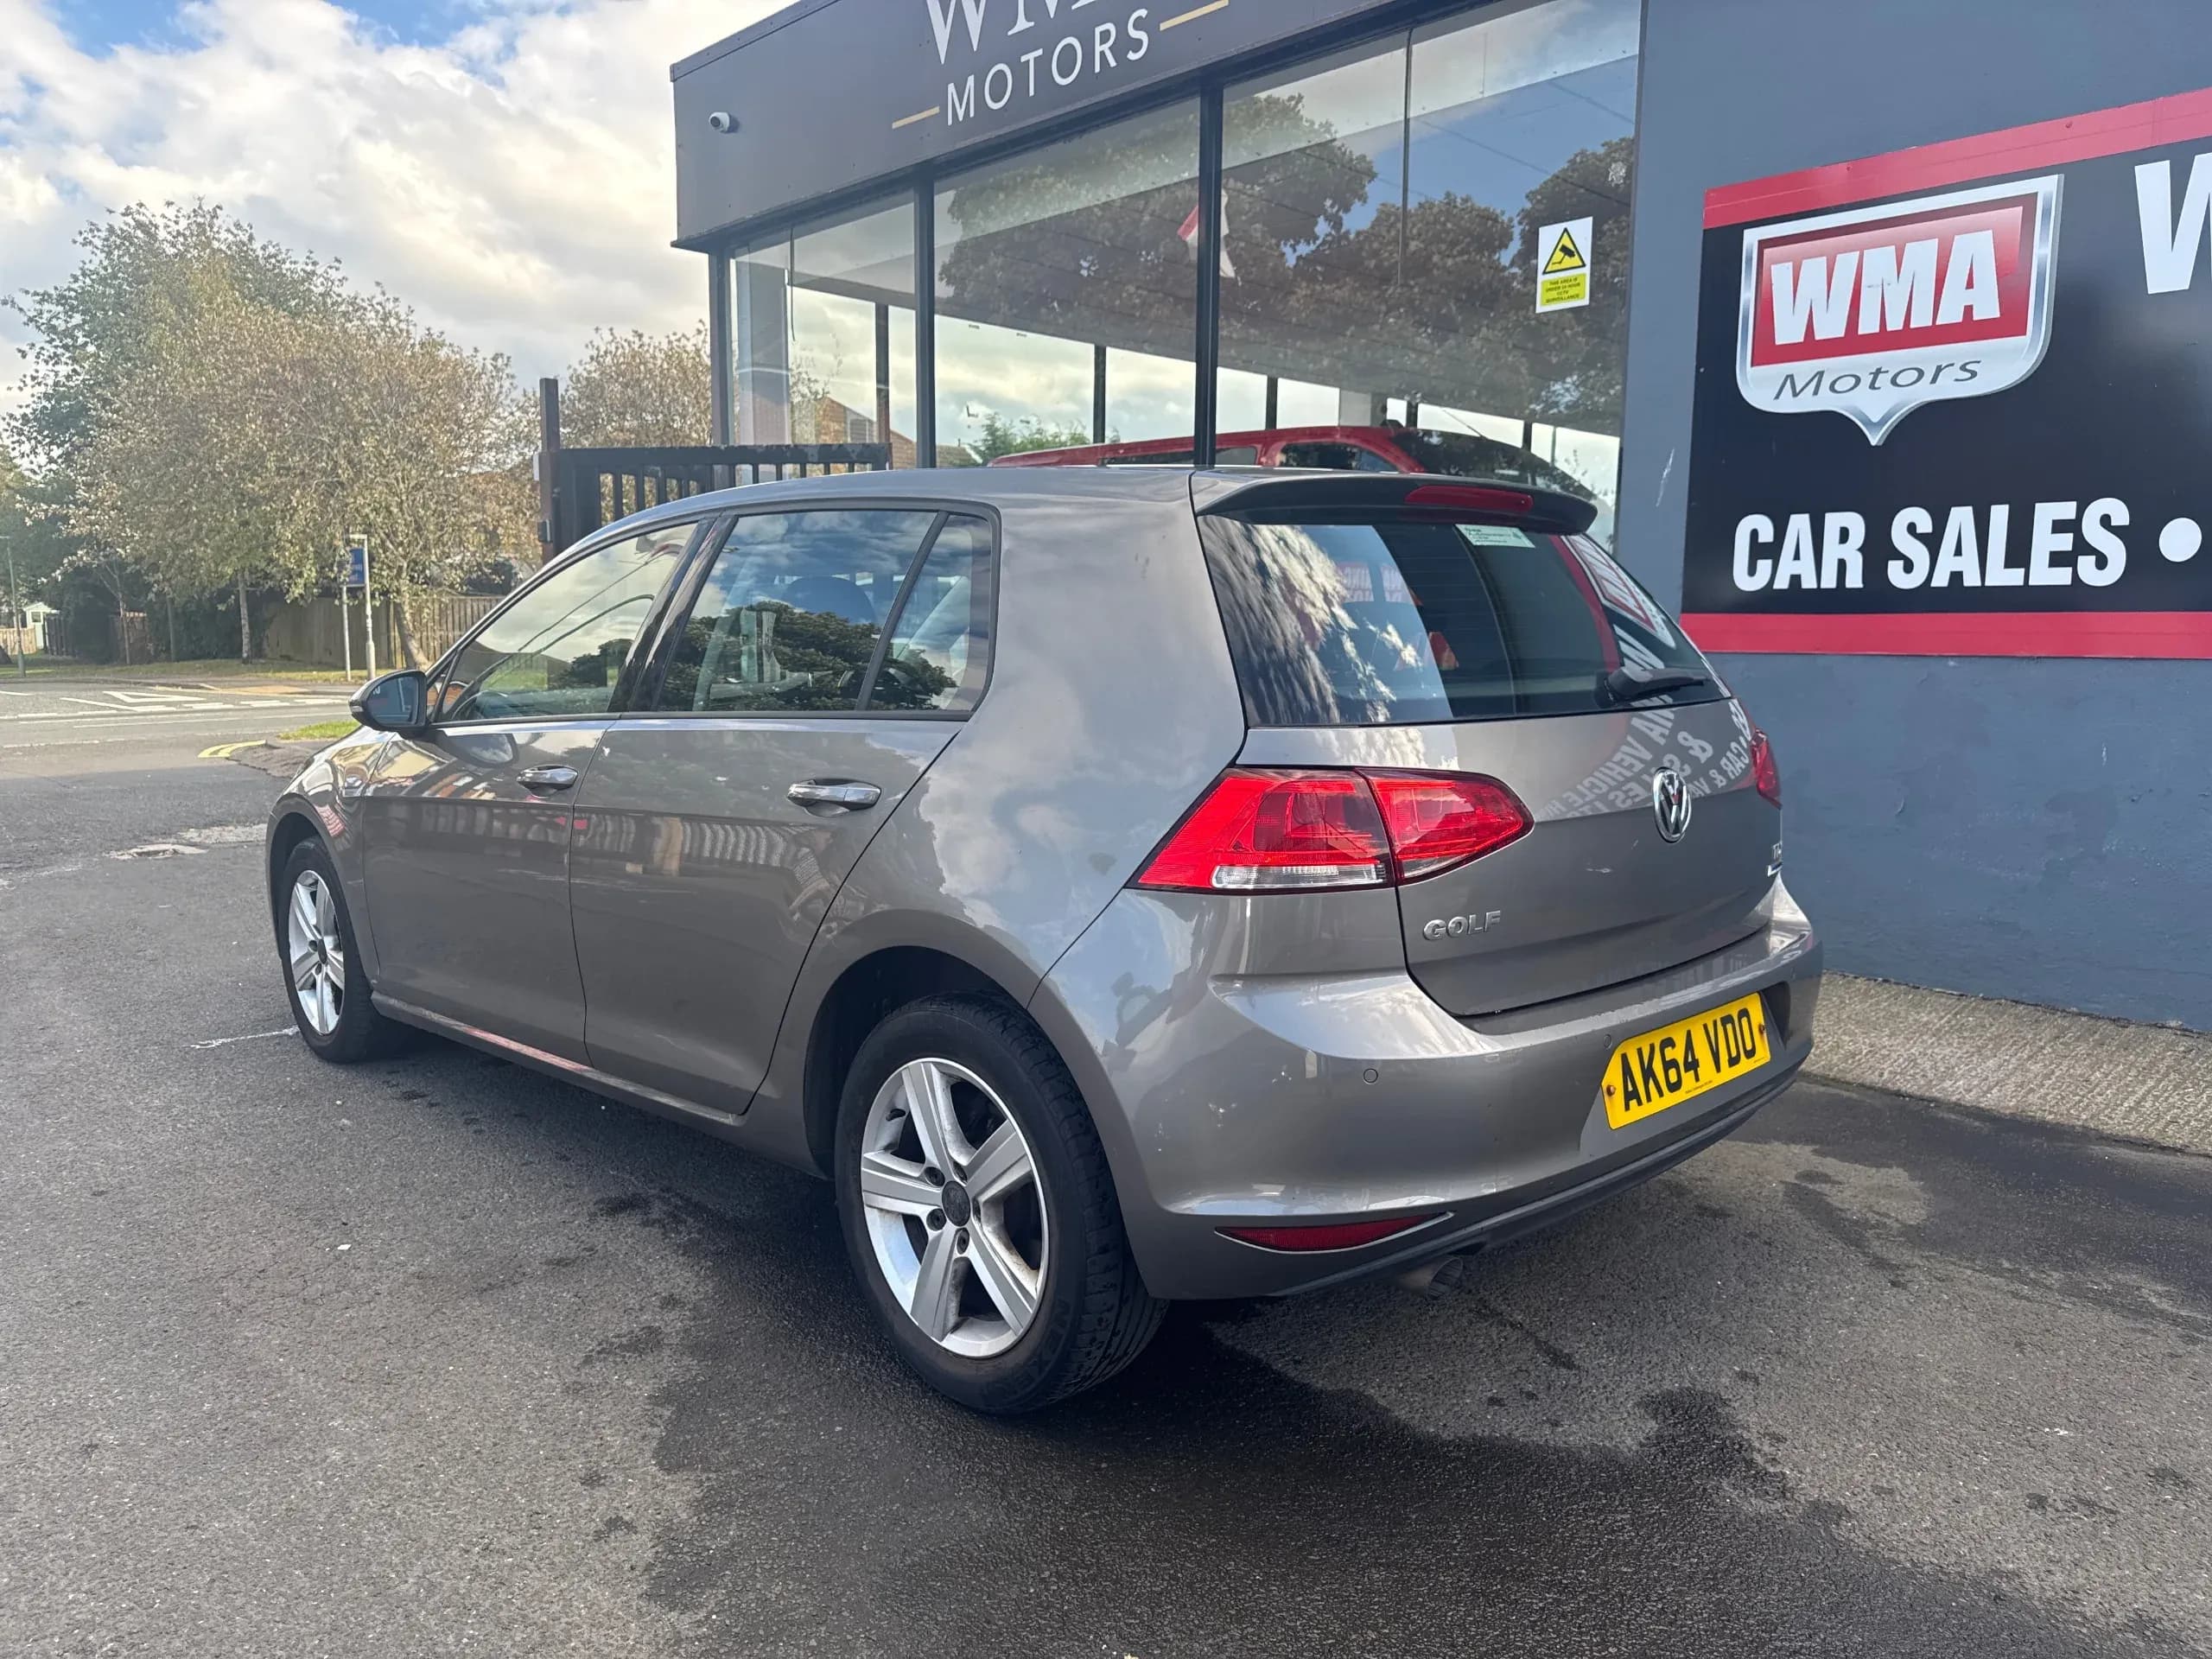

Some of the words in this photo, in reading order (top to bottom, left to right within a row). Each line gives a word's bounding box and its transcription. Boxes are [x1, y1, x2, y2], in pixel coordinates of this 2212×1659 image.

[947, 9, 1148, 126] MOTORS
[1770, 229, 2001, 346] WMA
[1774, 359, 1981, 401] Motors
[1732, 511, 1866, 592] CAR
[1886, 497, 2131, 590] SALES
[1422, 910, 1502, 941] GOLF
[1620, 1029, 1700, 1112] AK64
[1701, 1007, 1758, 1075] VDO
